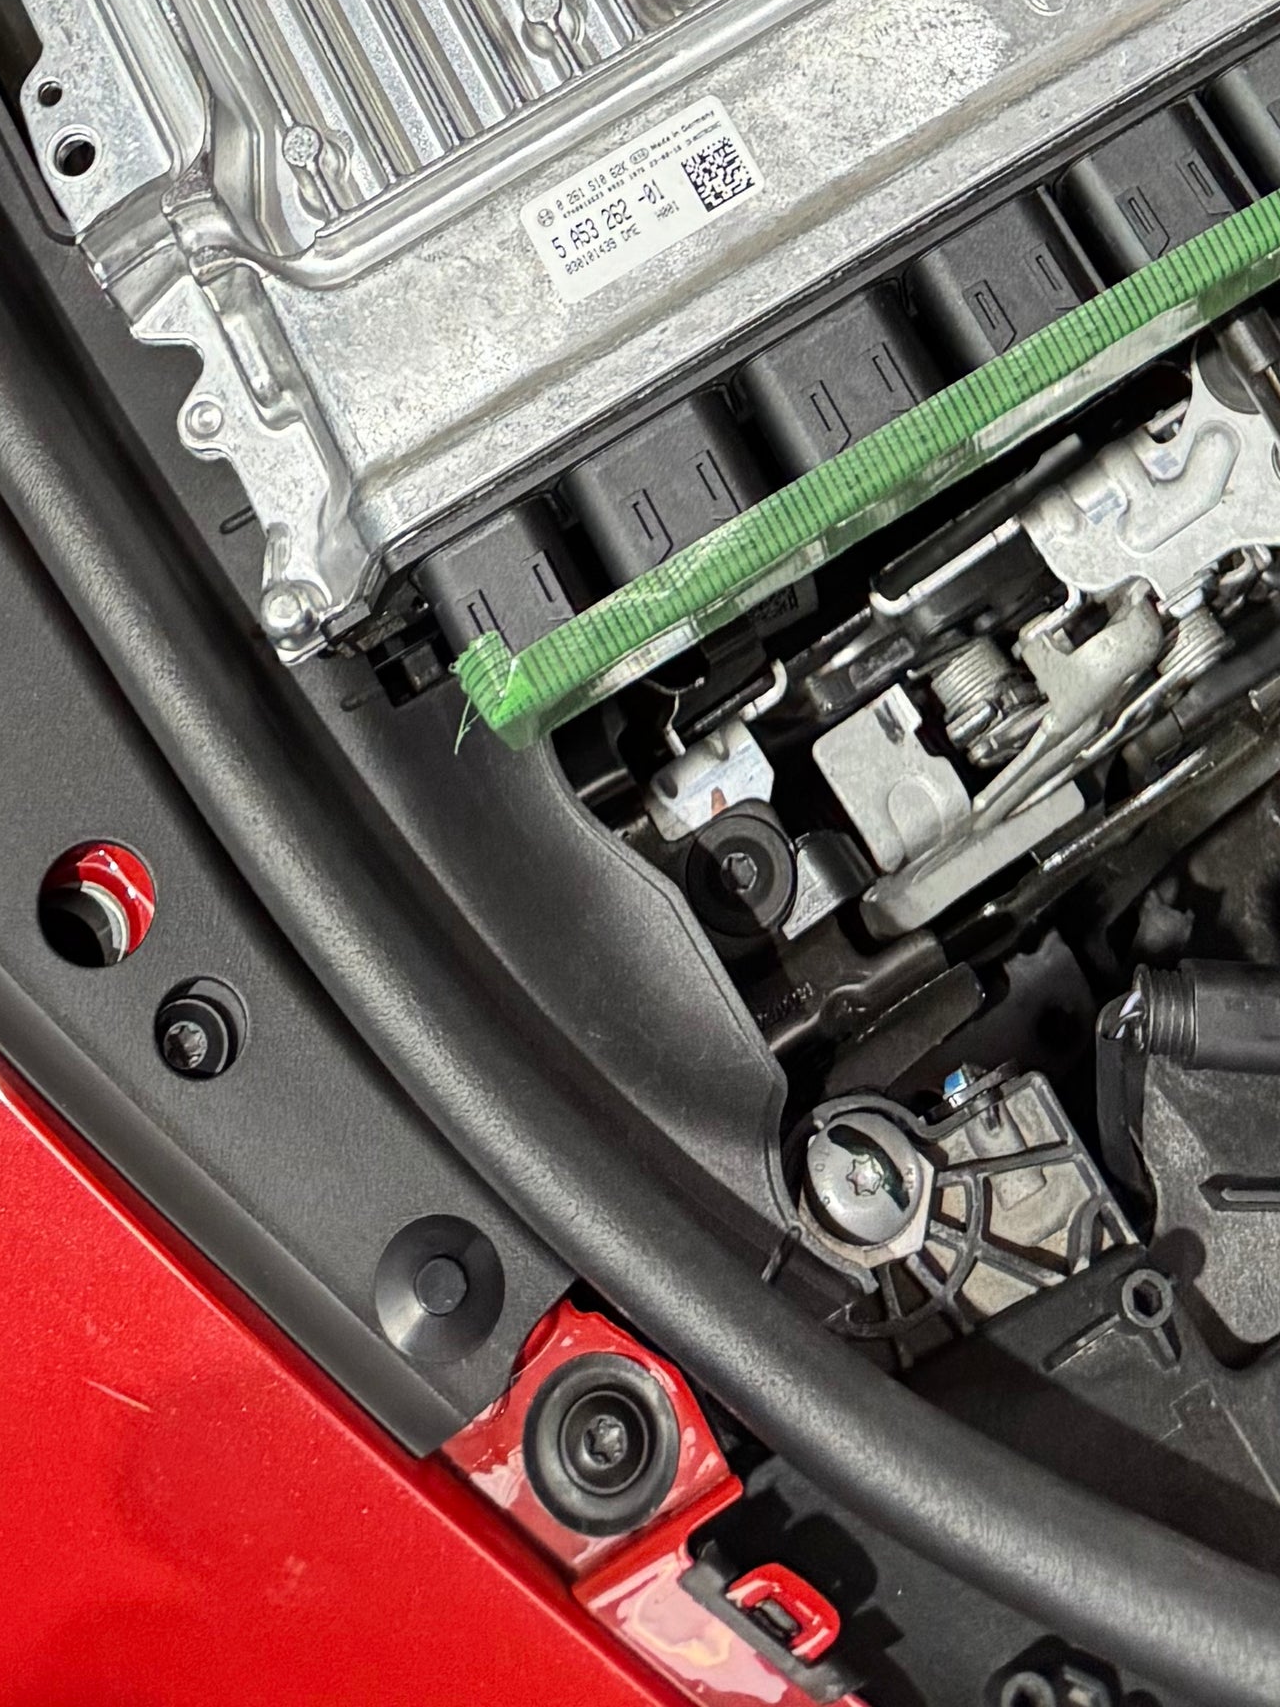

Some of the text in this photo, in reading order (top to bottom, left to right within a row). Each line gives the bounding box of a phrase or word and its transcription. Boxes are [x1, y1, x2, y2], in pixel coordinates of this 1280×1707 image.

[551, 236, 567, 259] 5
[569, 217, 600, 251] A53
[601, 198, 633, 231] 262
